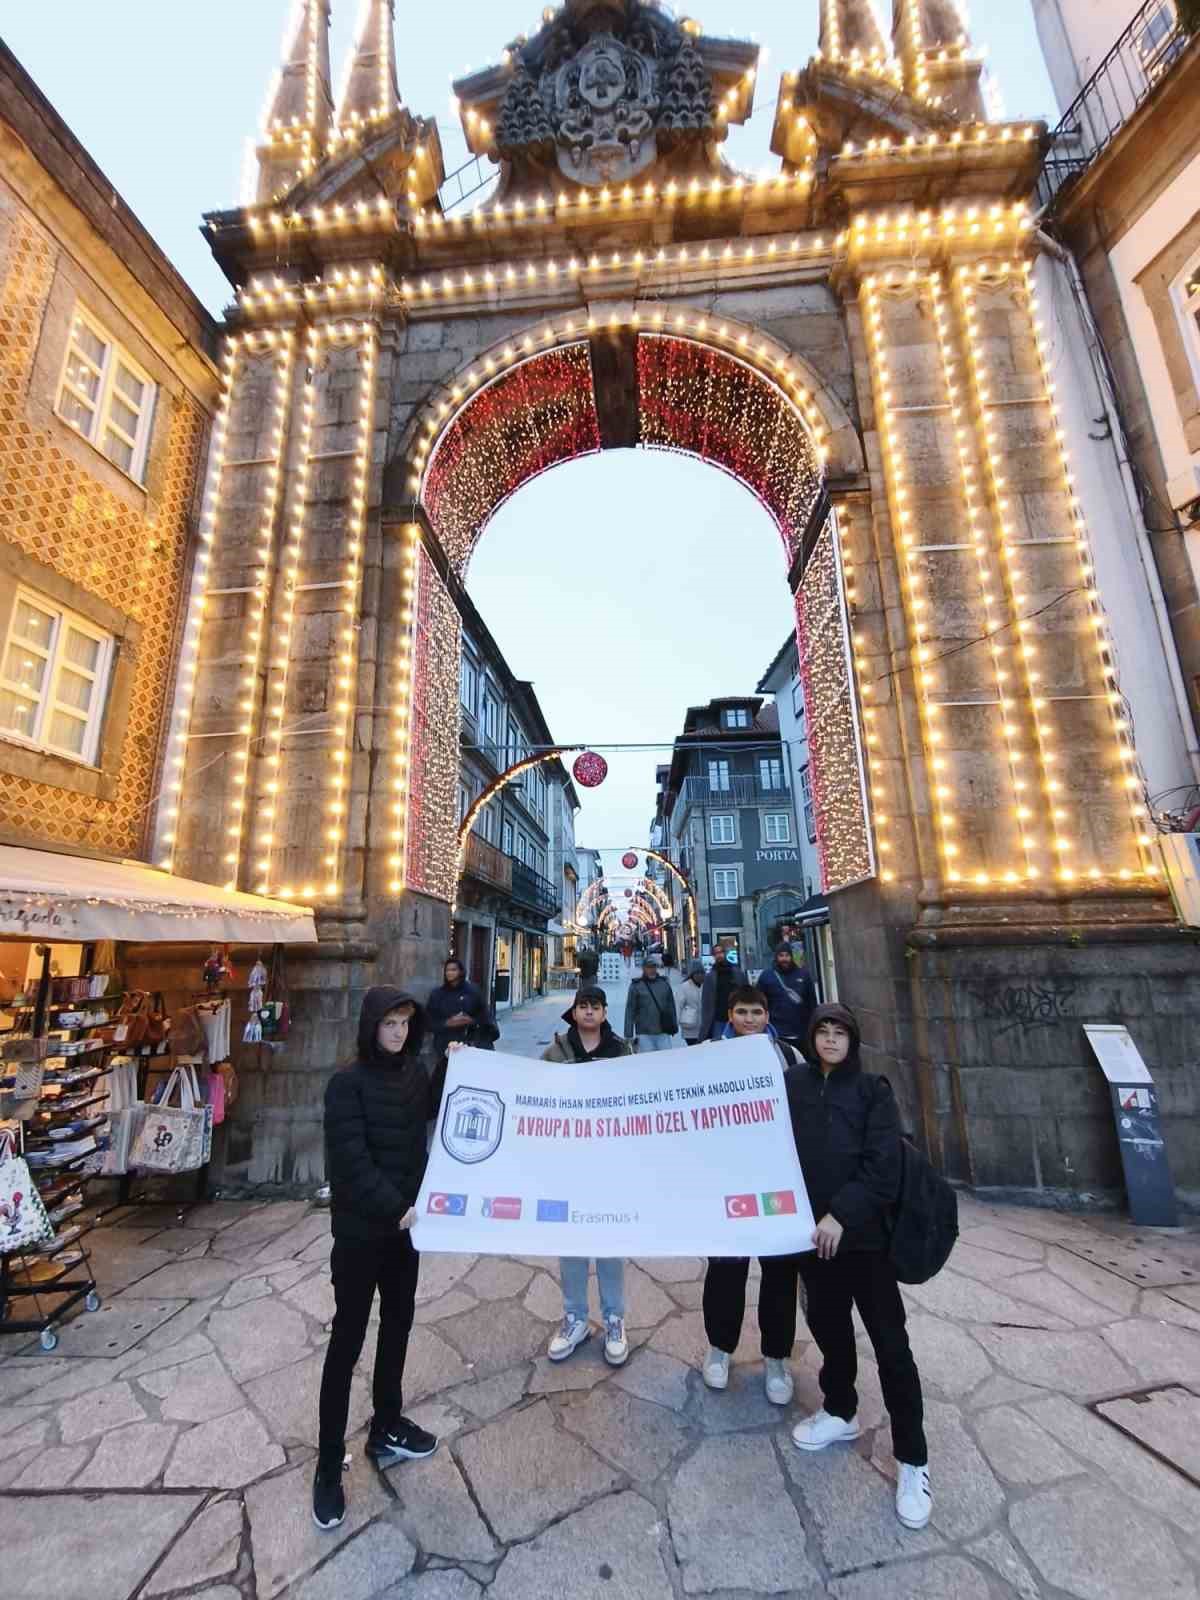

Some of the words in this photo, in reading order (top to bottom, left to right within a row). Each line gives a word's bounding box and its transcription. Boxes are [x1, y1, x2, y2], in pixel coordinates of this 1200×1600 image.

[756, 850, 797, 861] PORTA
[515, 1094, 556, 1108] MARMARİS
[559, 1095, 583, 1109] İHSAN
[664, 1089, 674, 1101] VE
[675, 1083, 706, 1100] TEKNİK
[708, 1080, 745, 1096] ANADOLU
[747, 1072, 774, 1090] LİSESİ
[596, 1114, 653, 1138] STAJIMI
[655, 1110, 688, 1134] ÖZEL
